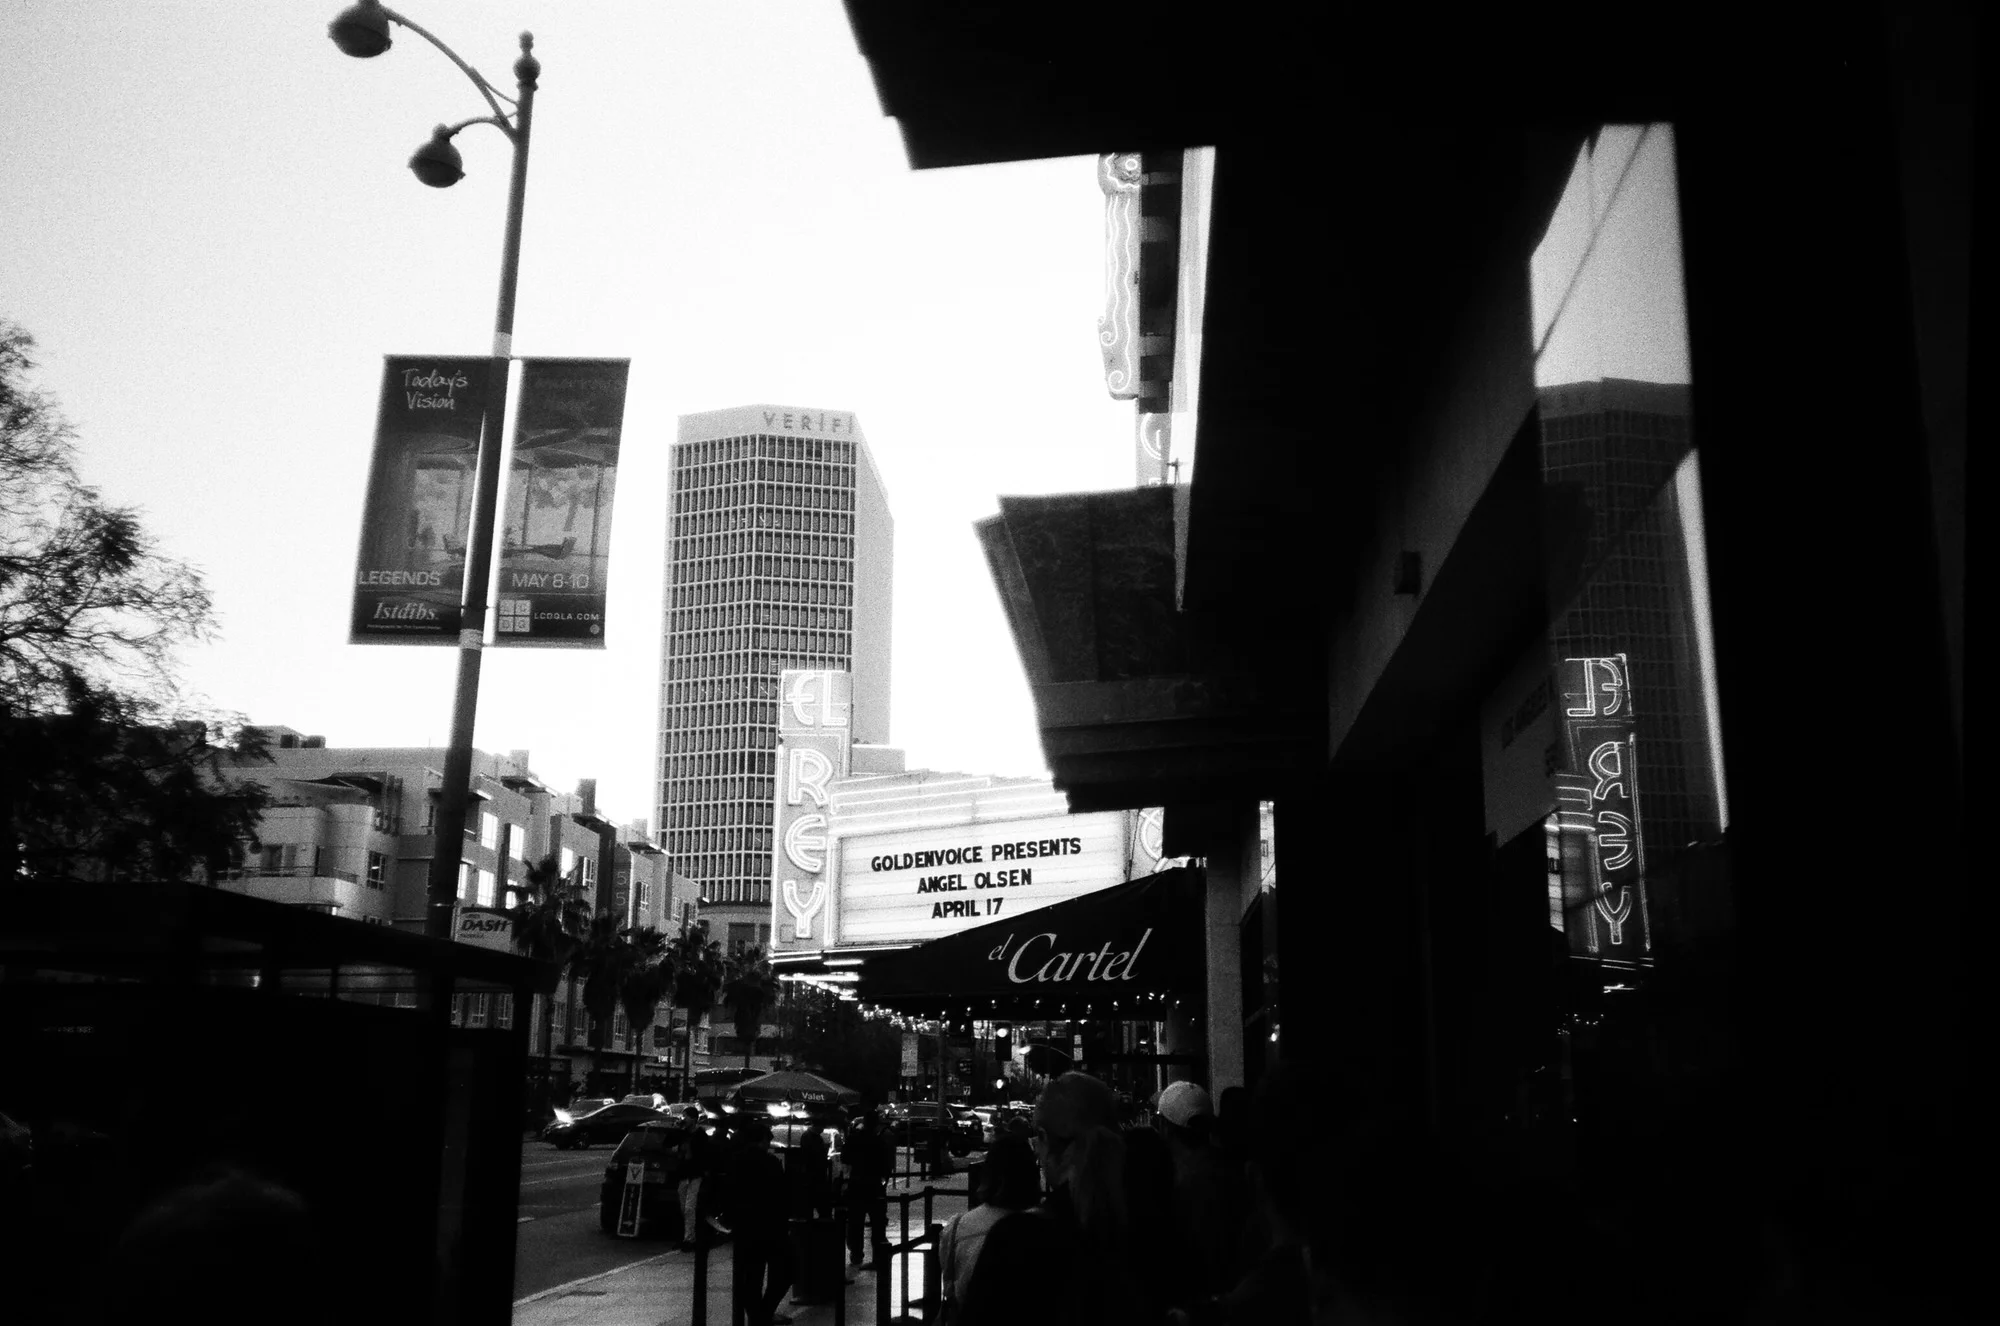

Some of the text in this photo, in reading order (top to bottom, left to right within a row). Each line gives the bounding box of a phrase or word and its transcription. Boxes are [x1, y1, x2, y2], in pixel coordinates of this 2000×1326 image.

[401, 367, 469, 396] Today's
[405, 391, 456, 411] Vision
[763, 411, 854, 433] VERIFI
[357, 570, 441, 587] LEGENDS
[512, 572, 589, 589] MAY 8-10
[786, 671, 848, 726] EL
[783, 748, 834, 939] REY
[871, 837, 1081, 872] GOLDENVOICE PRESENTS
[917, 868, 1032, 894] ANGEL OLSEN
[931, 897, 1004, 919] APRIL 17
[461, 919, 508, 932] DASH
[988, 927, 1154, 984] el Cartel
[801, 1091, 825, 1101] Valet
